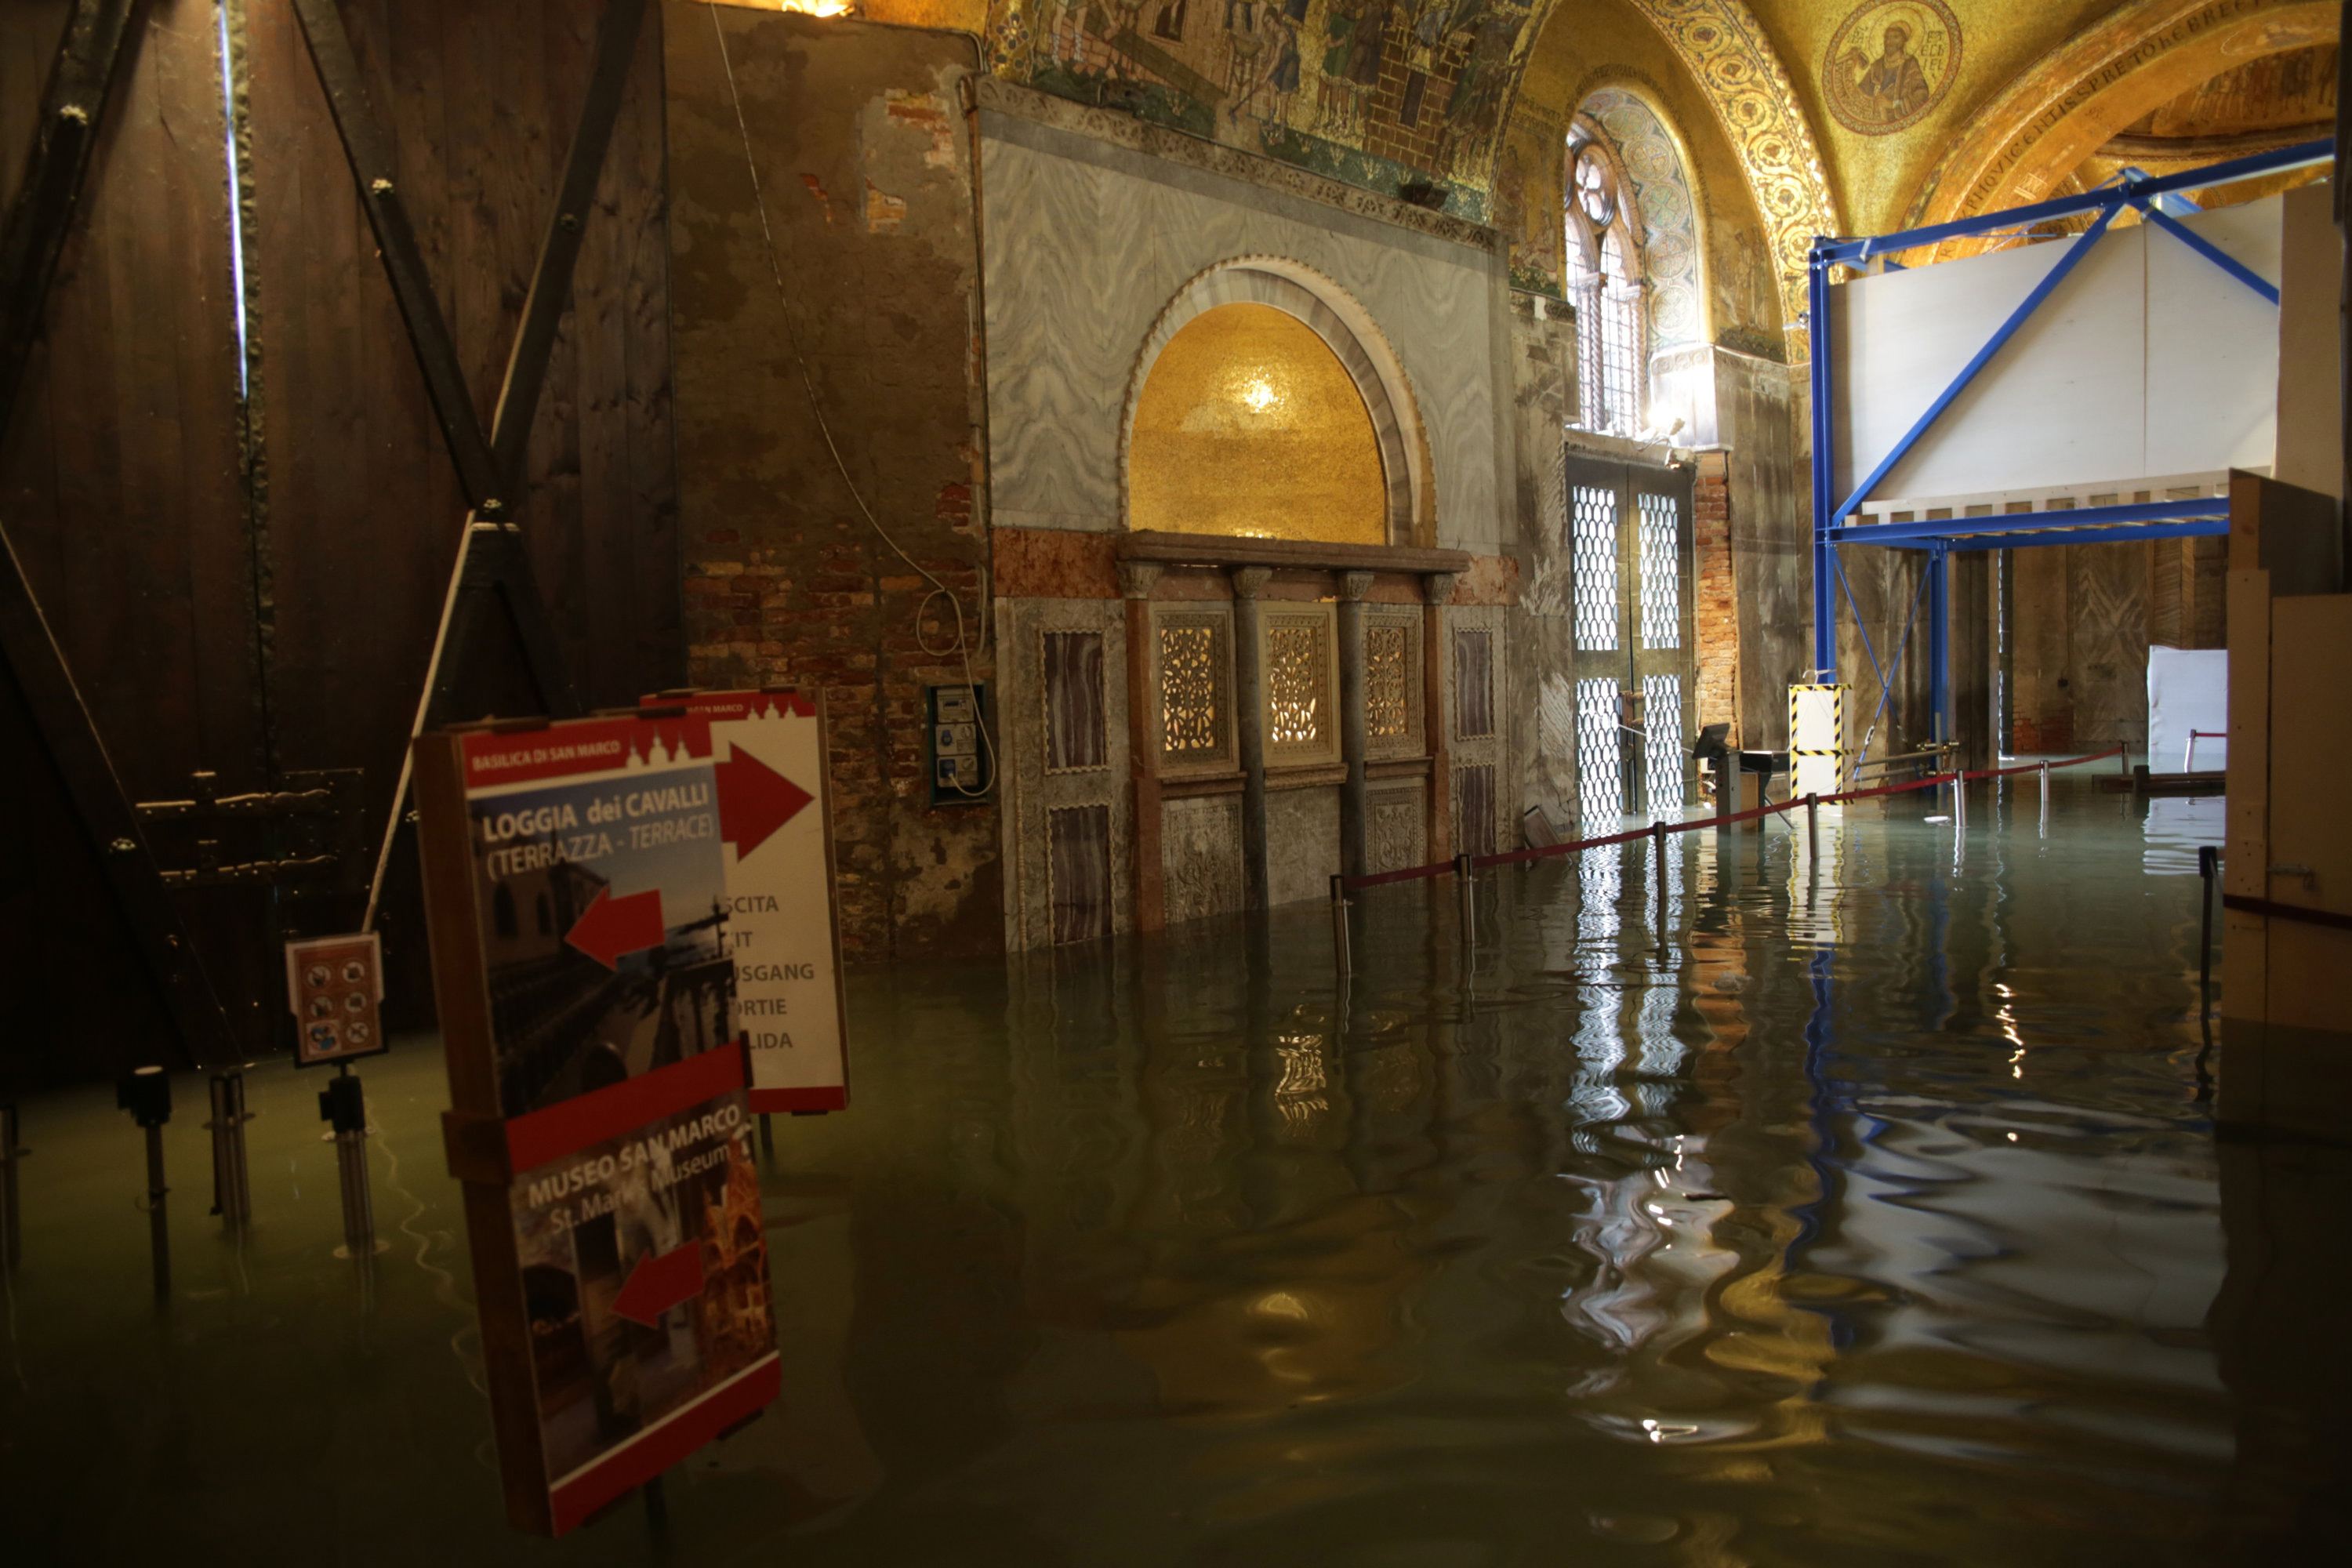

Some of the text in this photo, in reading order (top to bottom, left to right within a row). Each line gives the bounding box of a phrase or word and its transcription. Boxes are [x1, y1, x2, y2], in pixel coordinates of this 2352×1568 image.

[713, 704, 743, 713] MARCO
[471, 739, 622, 772] BASILICA DI SAN MARCO
[482, 782, 710, 844] LOGGIA dei CAVALLI
[487, 831, 614, 883] (TERRAZZA
[630, 812, 716, 850] TERRACE)
[727, 895, 779, 913] SCITA
[734, 931, 753, 948] IT
[734, 964, 815, 982] SGANG
[739, 999, 787, 1015] RTIE
[749, 1033, 793, 1049] LIDA
[528, 1104, 740, 1208] MUSEO SAN MARCO
[550, 1207, 579, 1235] St.
[652, 1142, 729, 1189] Museum
